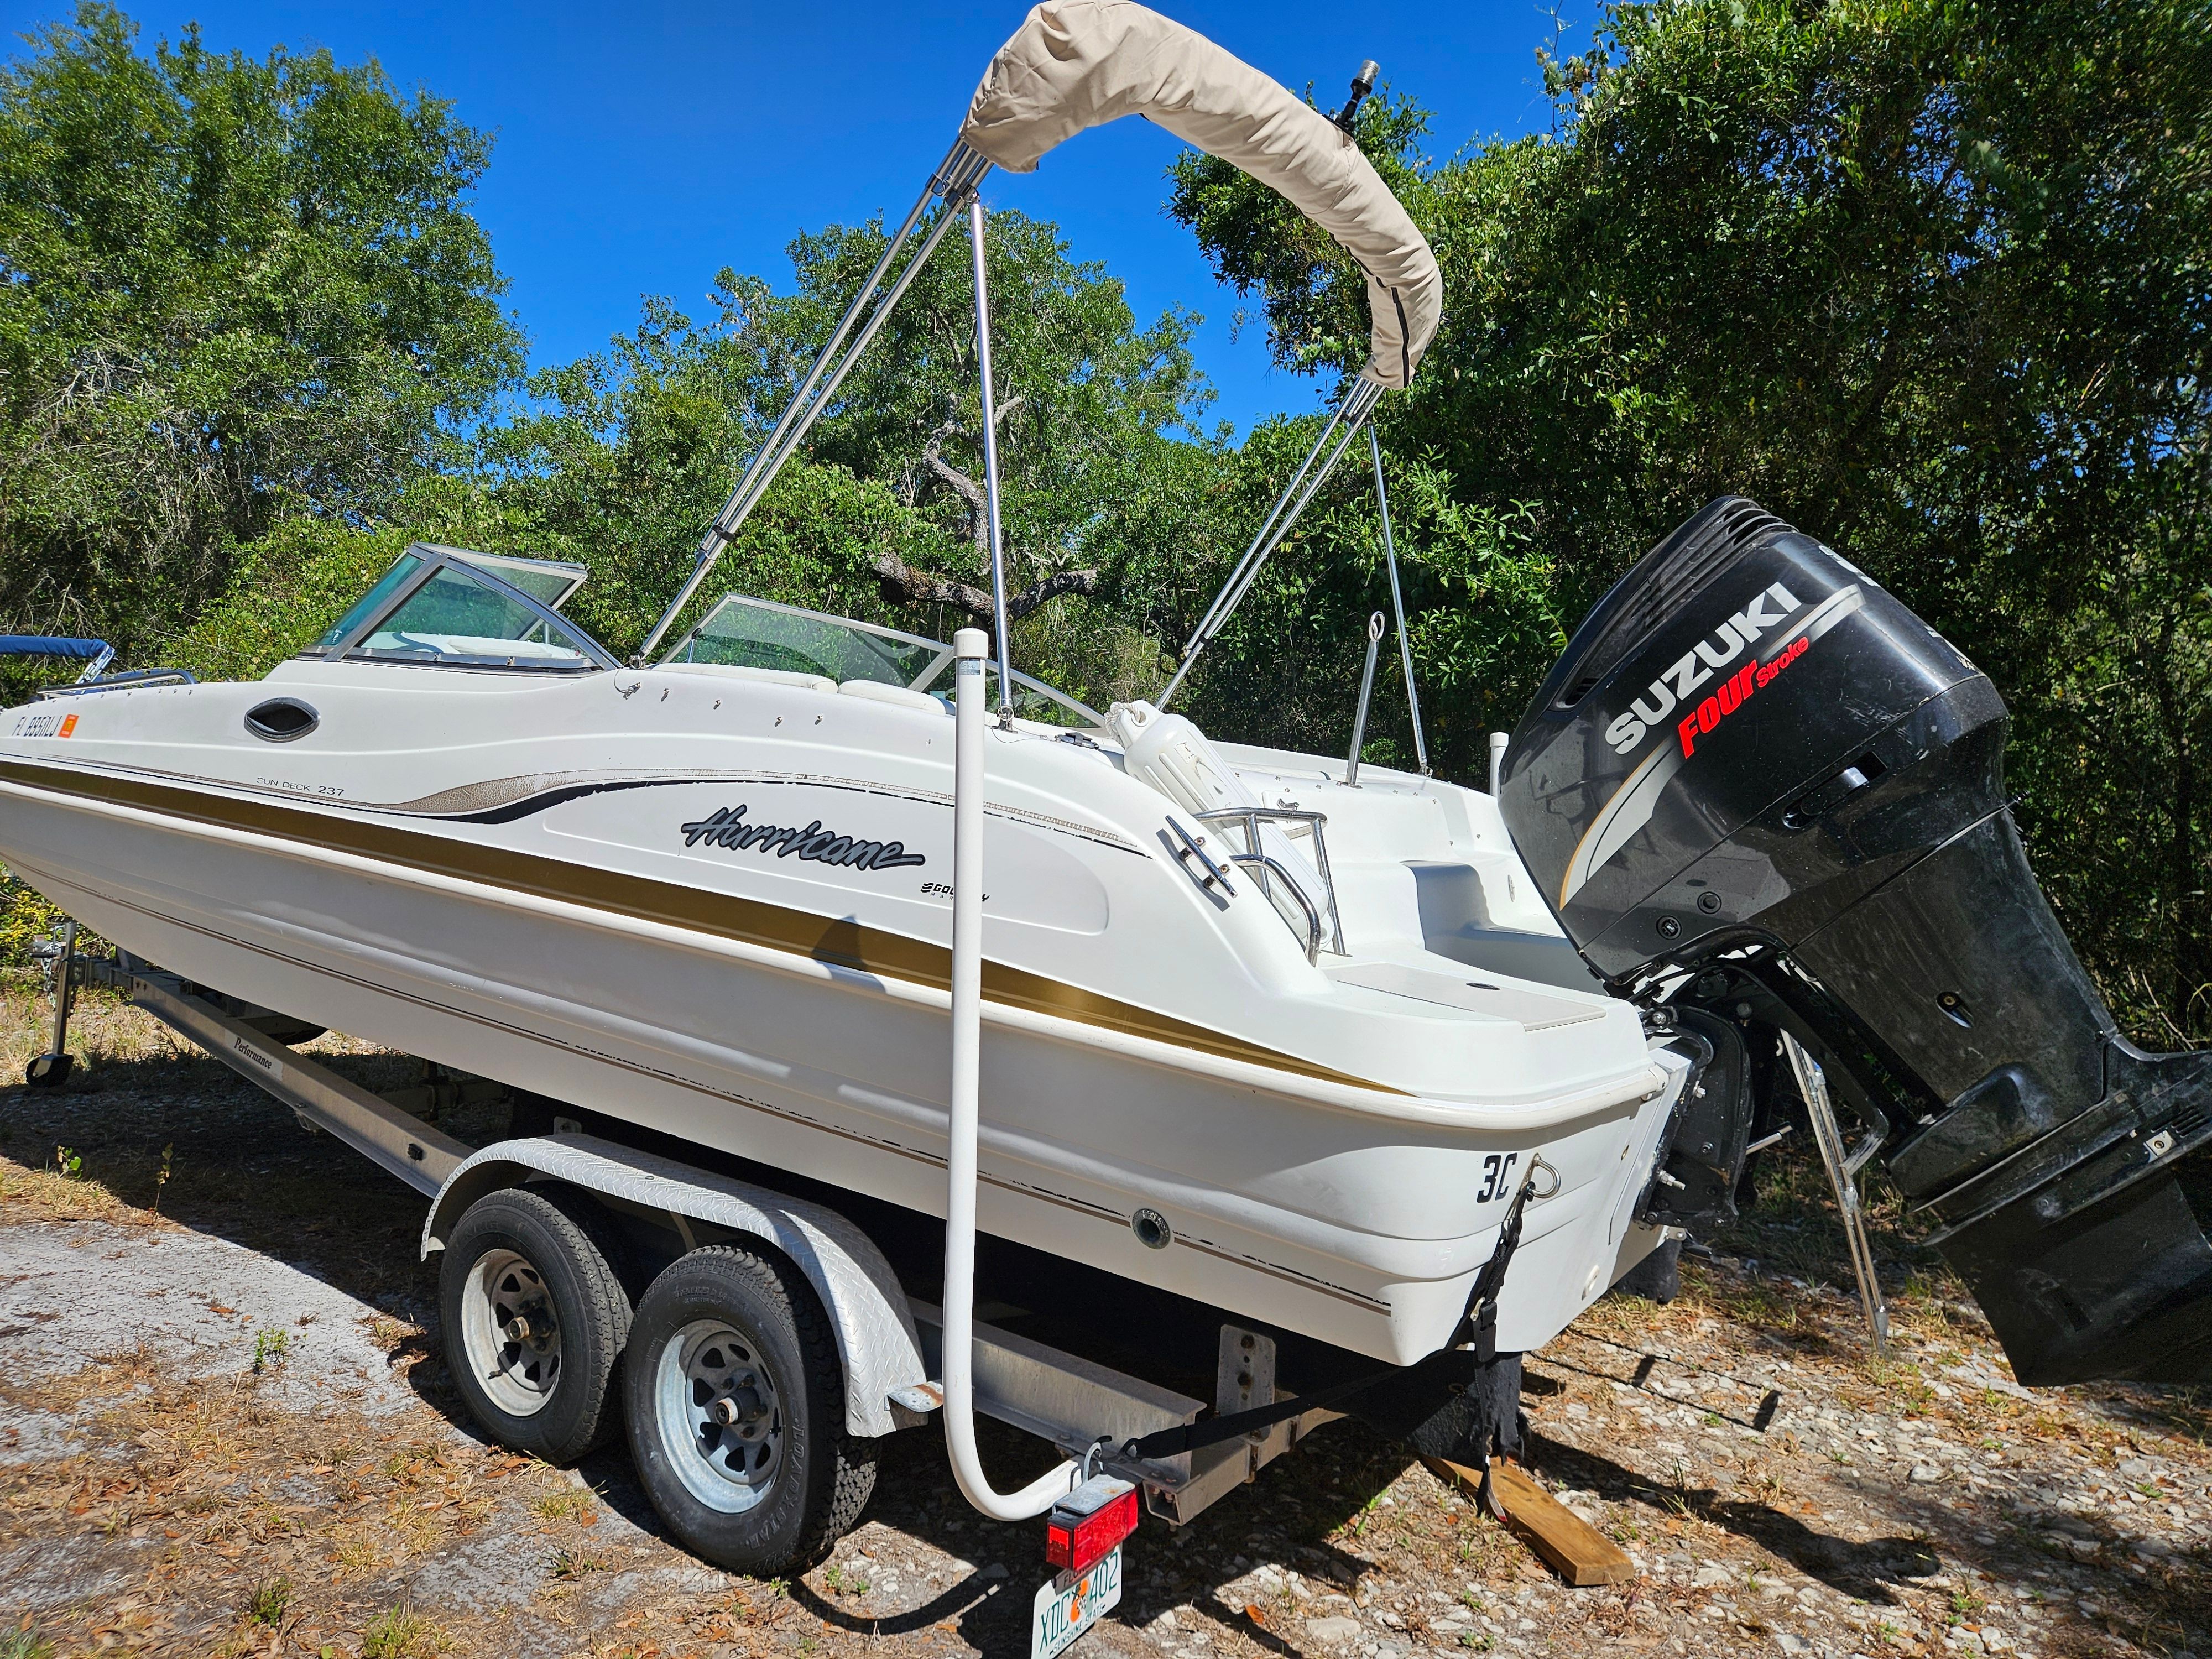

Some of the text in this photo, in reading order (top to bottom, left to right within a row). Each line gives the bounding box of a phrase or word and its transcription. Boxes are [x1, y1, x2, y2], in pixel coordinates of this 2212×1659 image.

[1605, 581, 1802, 755] SUZUKI
[12, 716, 28, 736] FL
[256, 777, 344, 796] SUN DECK 237
[681, 804, 926, 870] Hurricane
[234, 1037, 272, 1070] Performance
[1039, 1551, 1118, 1653] XDC 402
[1053, 1603, 1103, 1653] SUNSHINE STATE
